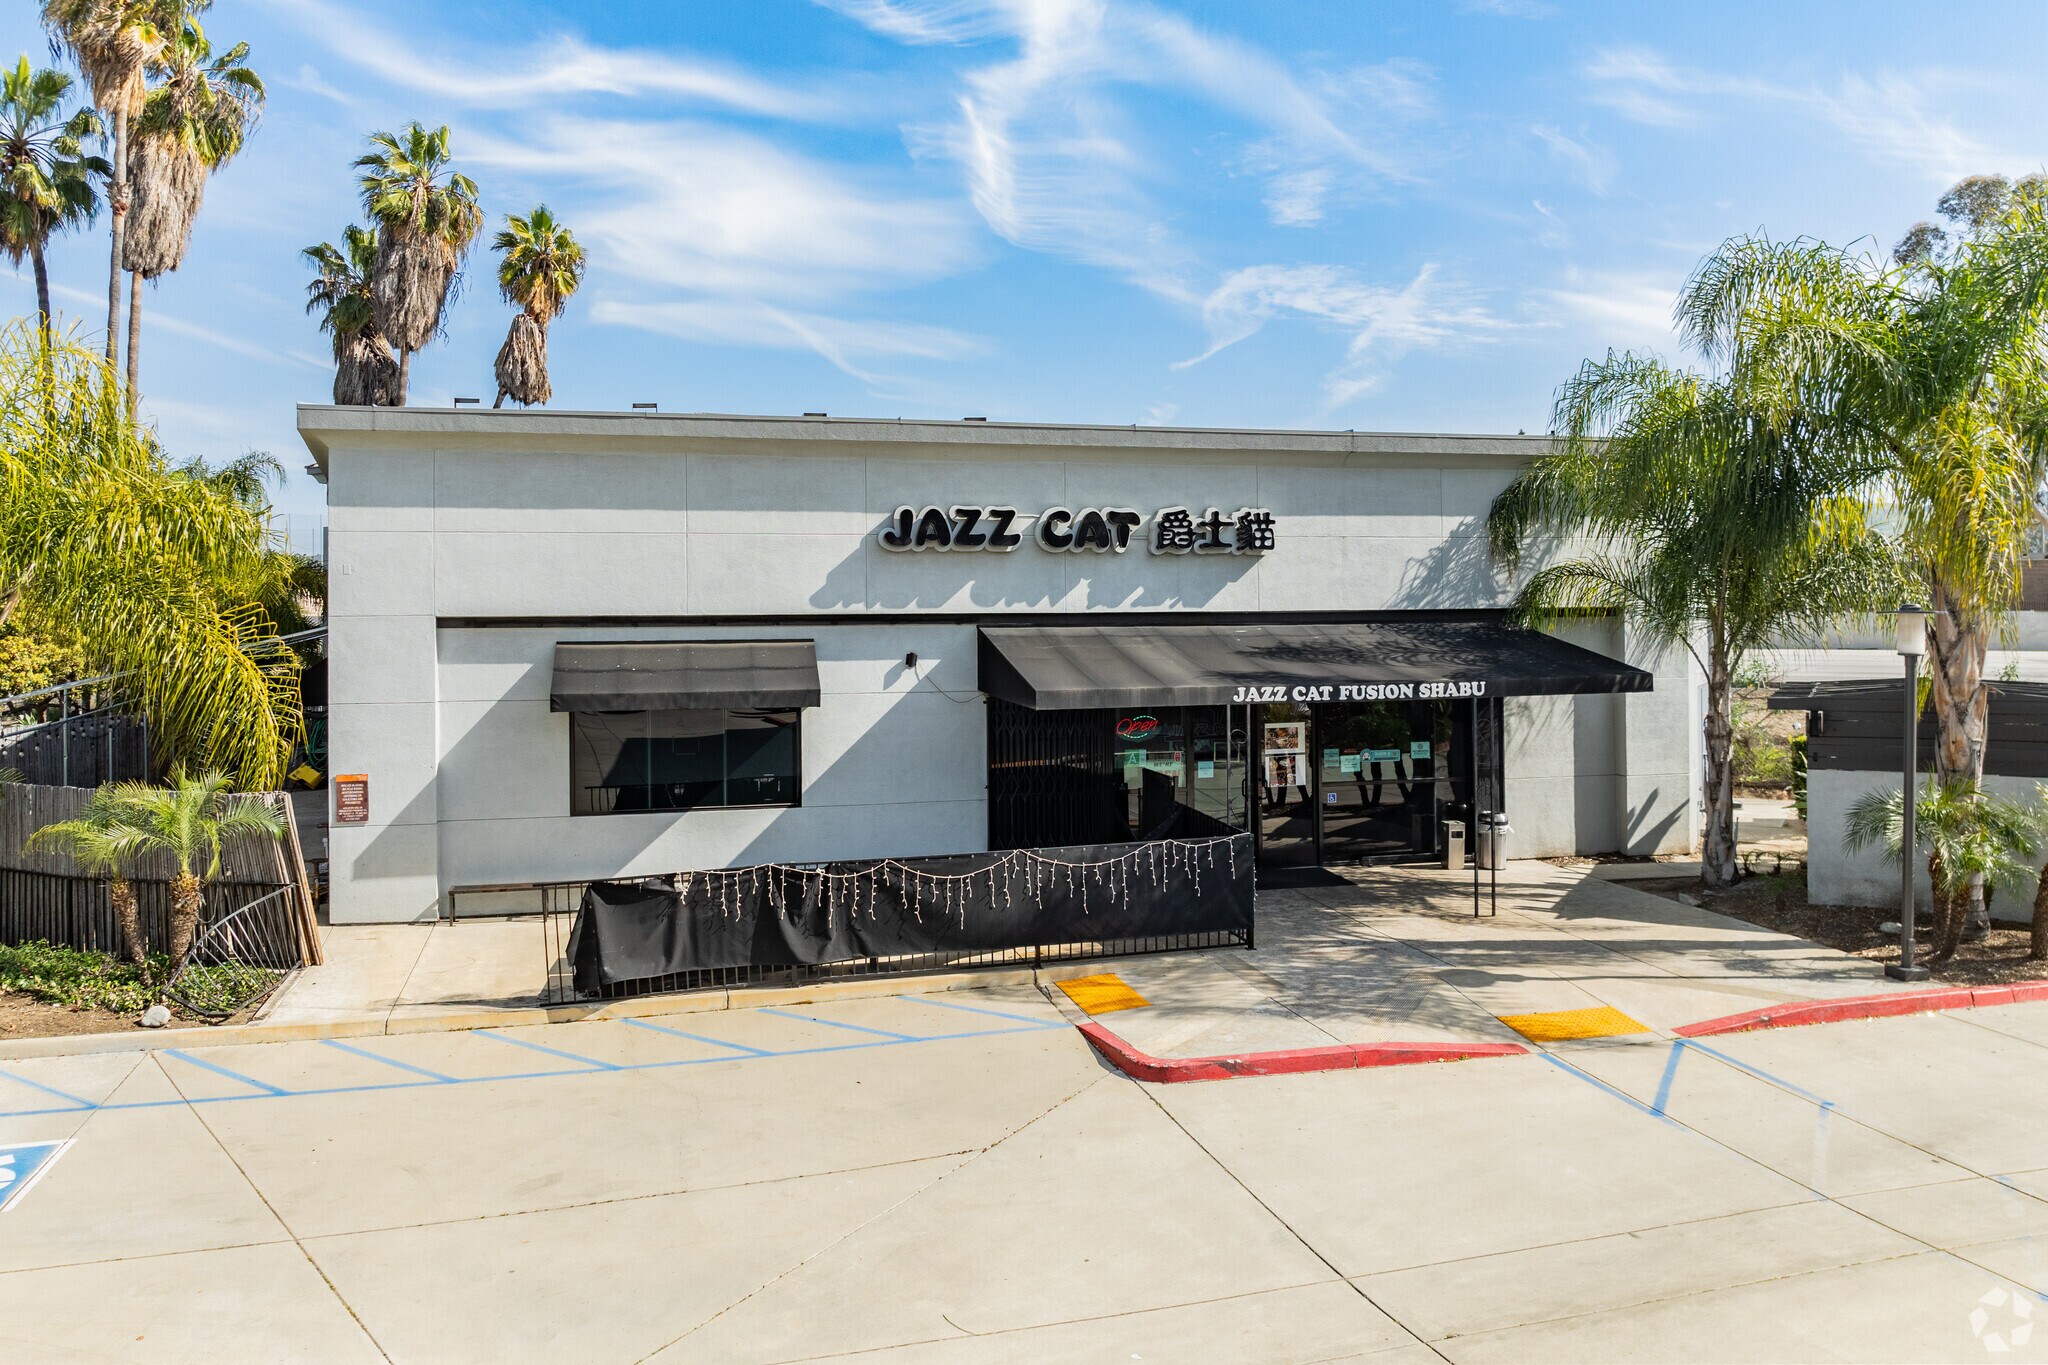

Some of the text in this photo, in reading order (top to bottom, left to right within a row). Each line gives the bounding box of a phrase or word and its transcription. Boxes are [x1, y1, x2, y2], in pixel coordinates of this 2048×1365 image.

[882, 507, 1141, 551] JAZZ CAT
[1157, 509, 1276, 551] 爵士貓
[1233, 681, 1487, 703] JAZZ CAT FUSION SHABU
[1116, 718, 1159, 735] Open
